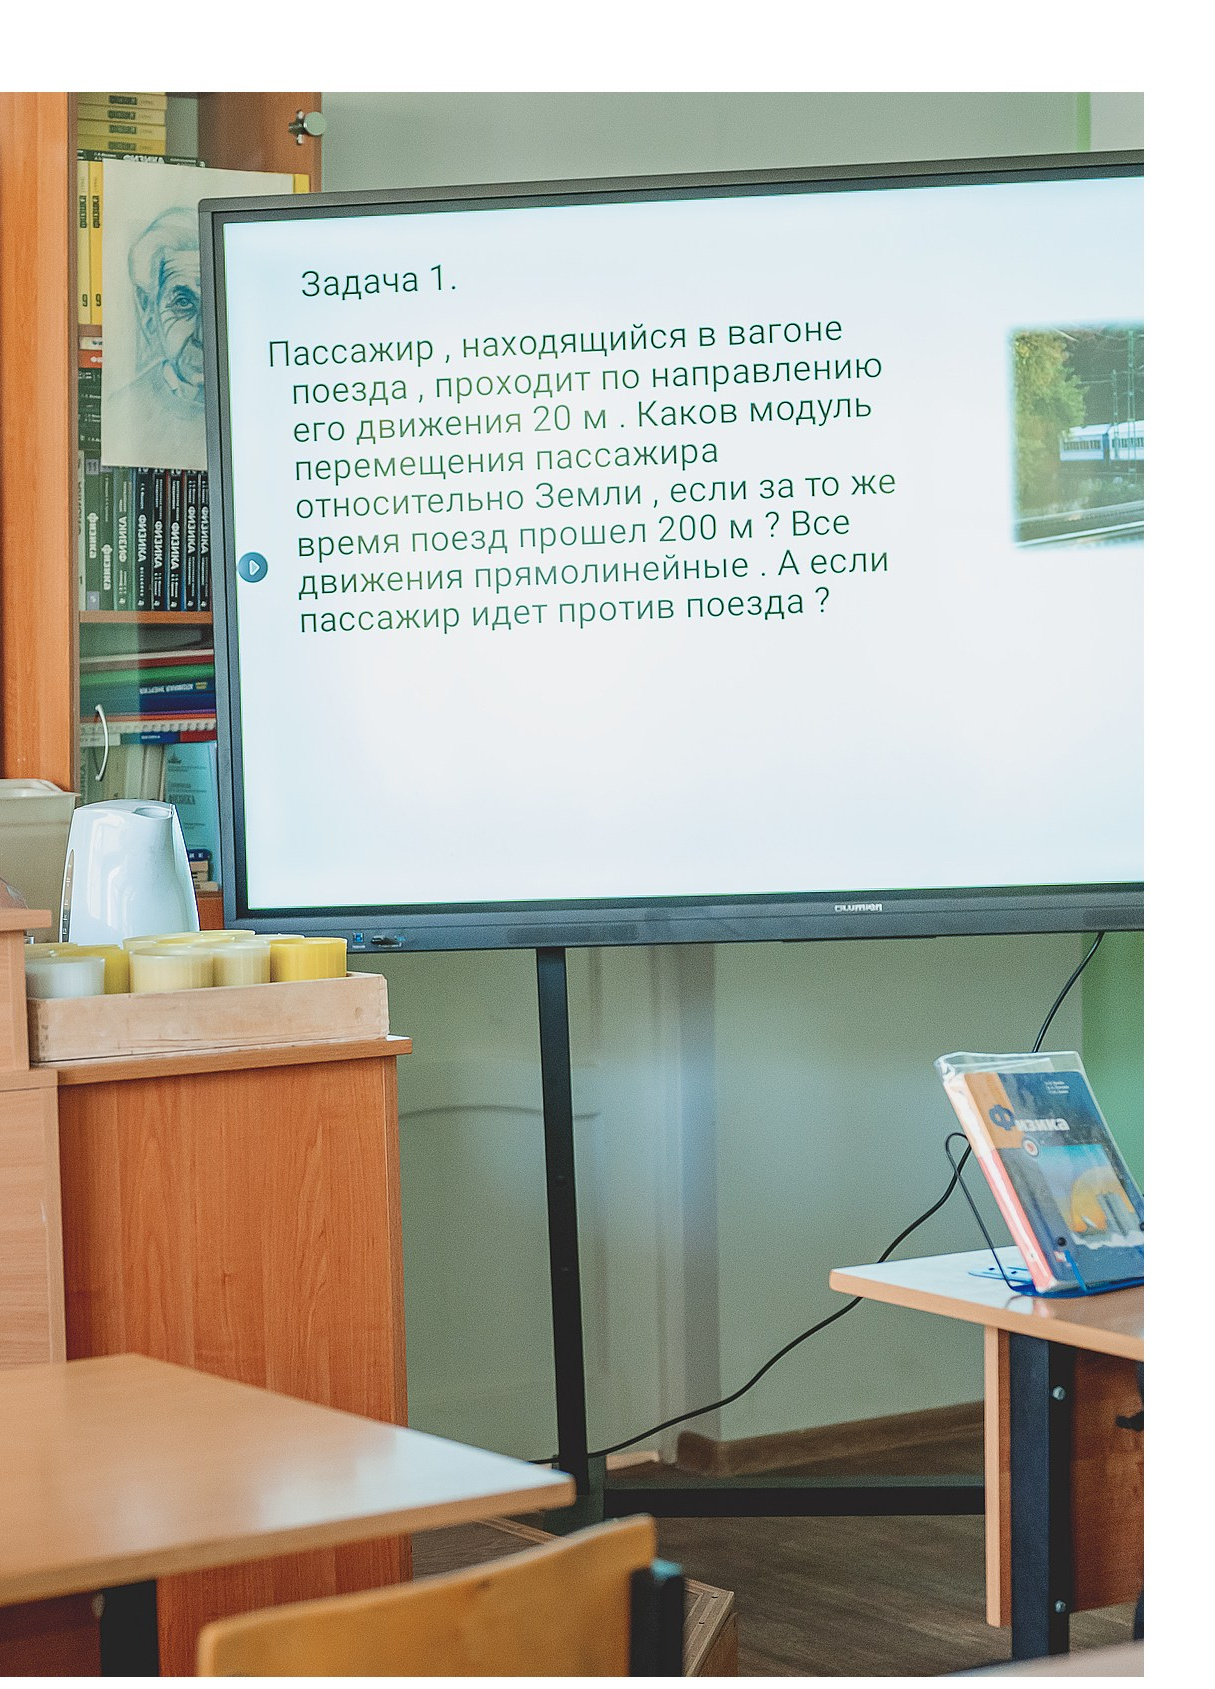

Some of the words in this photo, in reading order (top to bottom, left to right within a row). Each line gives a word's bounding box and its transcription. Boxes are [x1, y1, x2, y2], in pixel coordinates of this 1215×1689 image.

[301, 270, 419, 301] Задача
[430, 264, 456, 291] 1.
[269, 339, 434, 368] Пассажир
[462, 323, 686, 361] находящийся
[698, 326, 716, 347] в
[728, 320, 843, 346] вагоне
[292, 379, 407, 407] поезда
[435, 371, 591, 405] проходит
[602, 369, 640, 391] по
[652, 357, 882, 393] направлению
[293, 420, 345, 443] его
[356, 413, 521, 446] движения
[533, 404, 571, 432] 20
[584, 409, 607, 430] м
[638, 400, 738, 428] Каков
[750, 397, 872, 427] модуль
[295, 451, 524, 487] перемещения
[536, 442, 718, 472] пассажира
[296, 489, 524, 519] относительно
[535, 482, 642, 509] Земли
[670, 480, 747, 503] если
[759, 478, 794, 500] за
[804, 476, 840, 497] то
[850, 473, 896, 496] же
[298, 533, 399, 564] время
[411, 529, 508, 555] поезд
[519, 523, 646, 555] прошел
[658, 513, 717, 542] 200
[730, 518, 753, 540] м
[792, 510, 850, 537] Все
[298, 569, 463, 601] движения
[475, 553, 749, 595] прямолинейные
[777, 549, 801, 576] А
[810, 551, 888, 575] если
[300, 607, 460, 635] пассажир
[472, 604, 548, 632] идет
[559, 599, 675, 630] против
[687, 593, 804, 621] поезда
